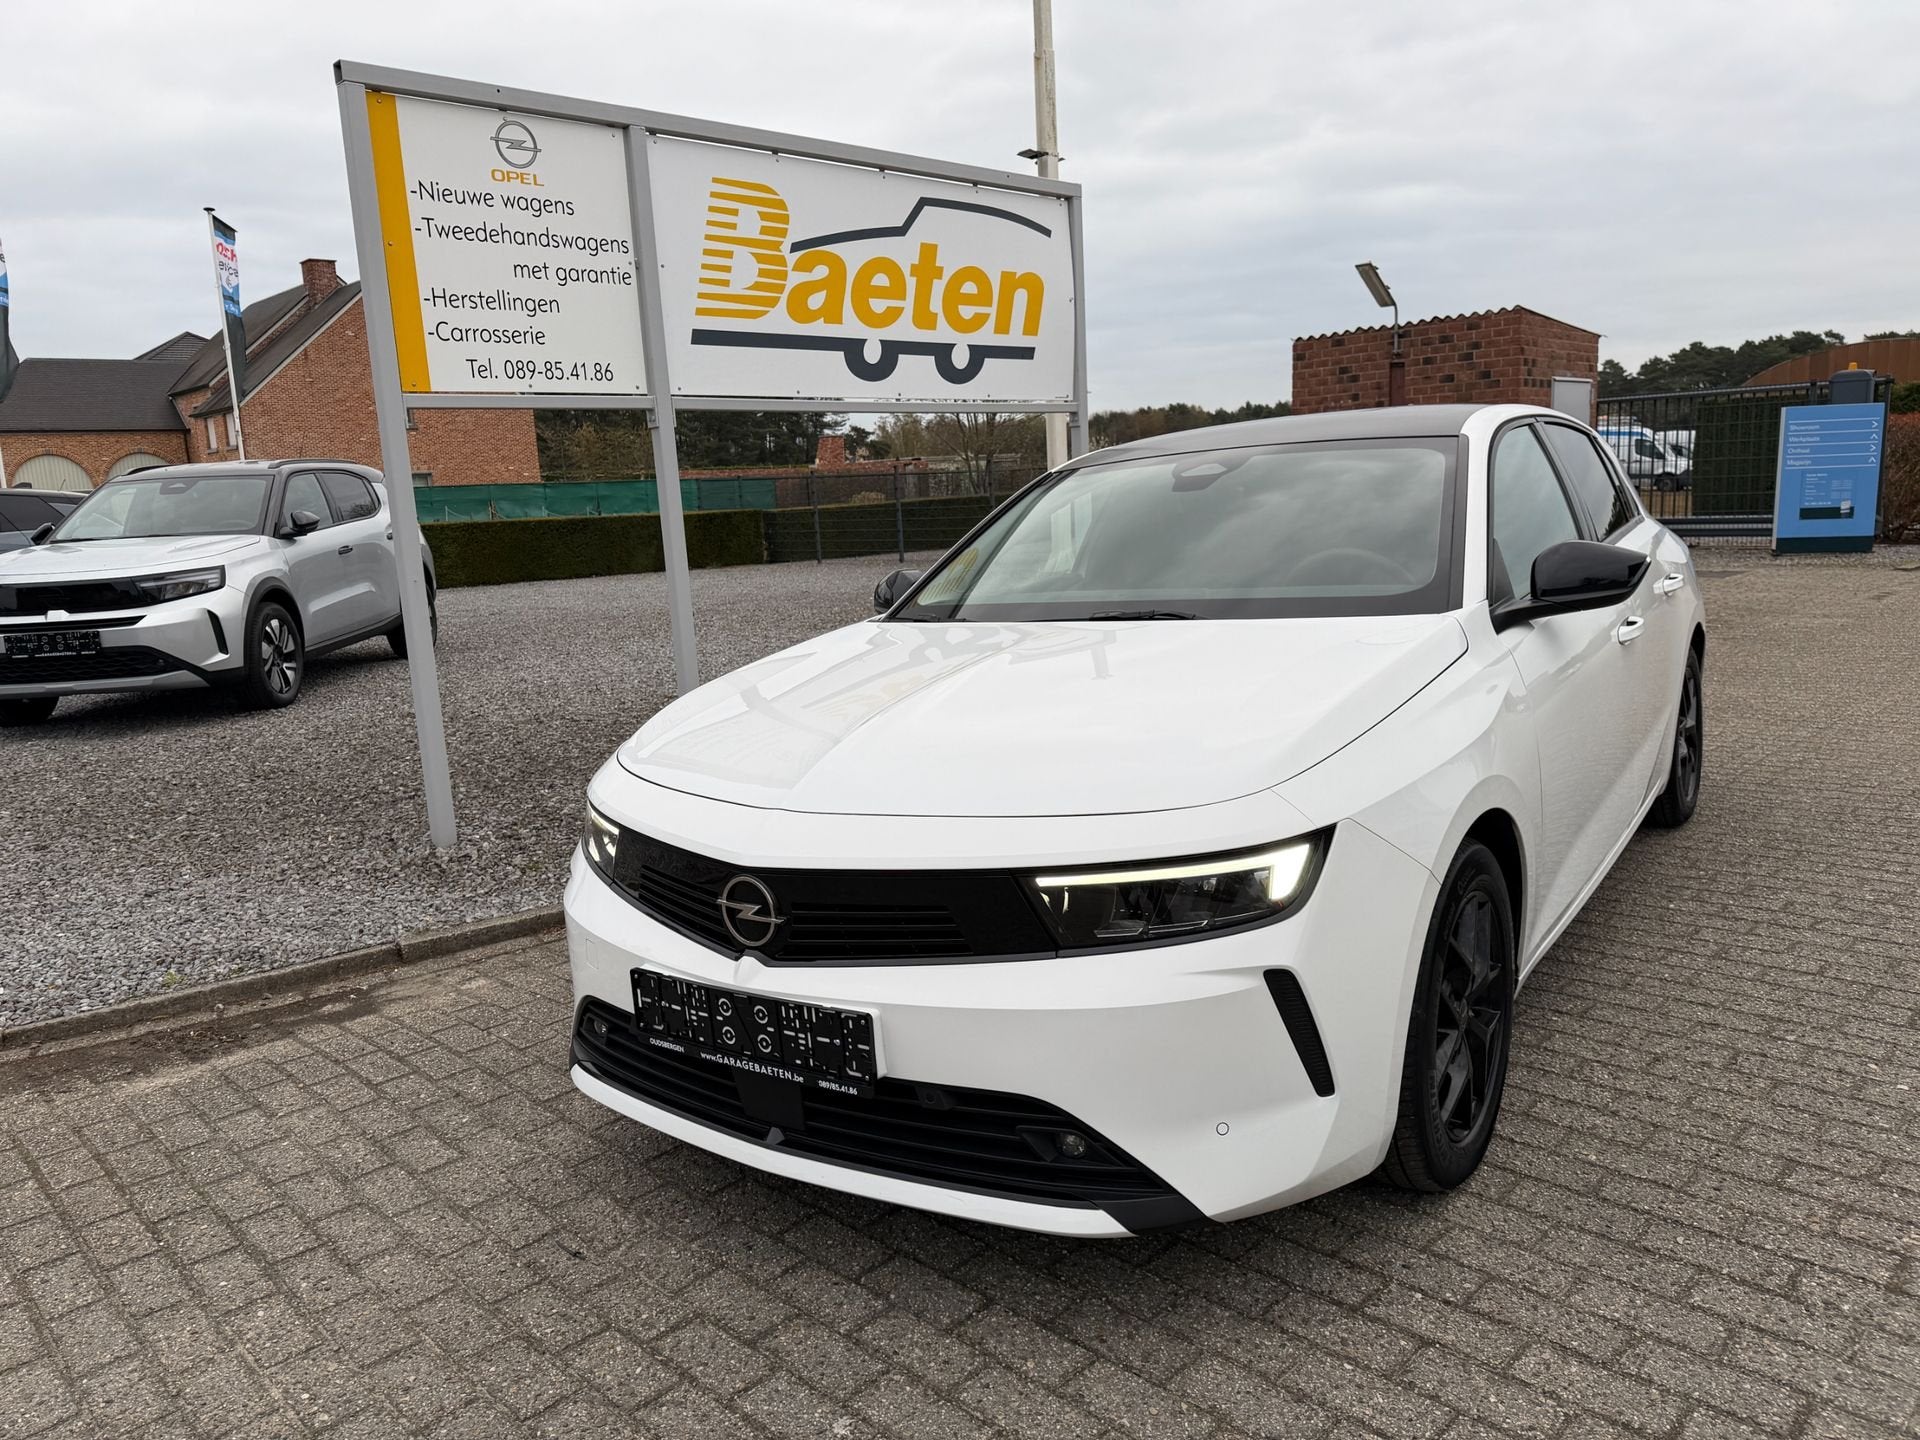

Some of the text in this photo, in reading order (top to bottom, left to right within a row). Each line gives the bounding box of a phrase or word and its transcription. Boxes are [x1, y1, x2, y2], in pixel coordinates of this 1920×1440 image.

[490, 168, 545, 187] OPEL
[410, 180, 575, 217] -Nieuwe wagens
[414, 217, 630, 257] -Tweedehandswagens
[695, 176, 1045, 337] Baeten
[513, 261, 632, 287] met garantie
[423, 287, 561, 318] -Herstellingen
[428, 321, 546, 345] -Carrosserie
[465, 357, 614, 382] Tel. 089-85.41.86
[649, 1037, 685, 1053] OUDSBERGEN
[700, 1051, 804, 1083] www.GARAGEBAETEN.be
